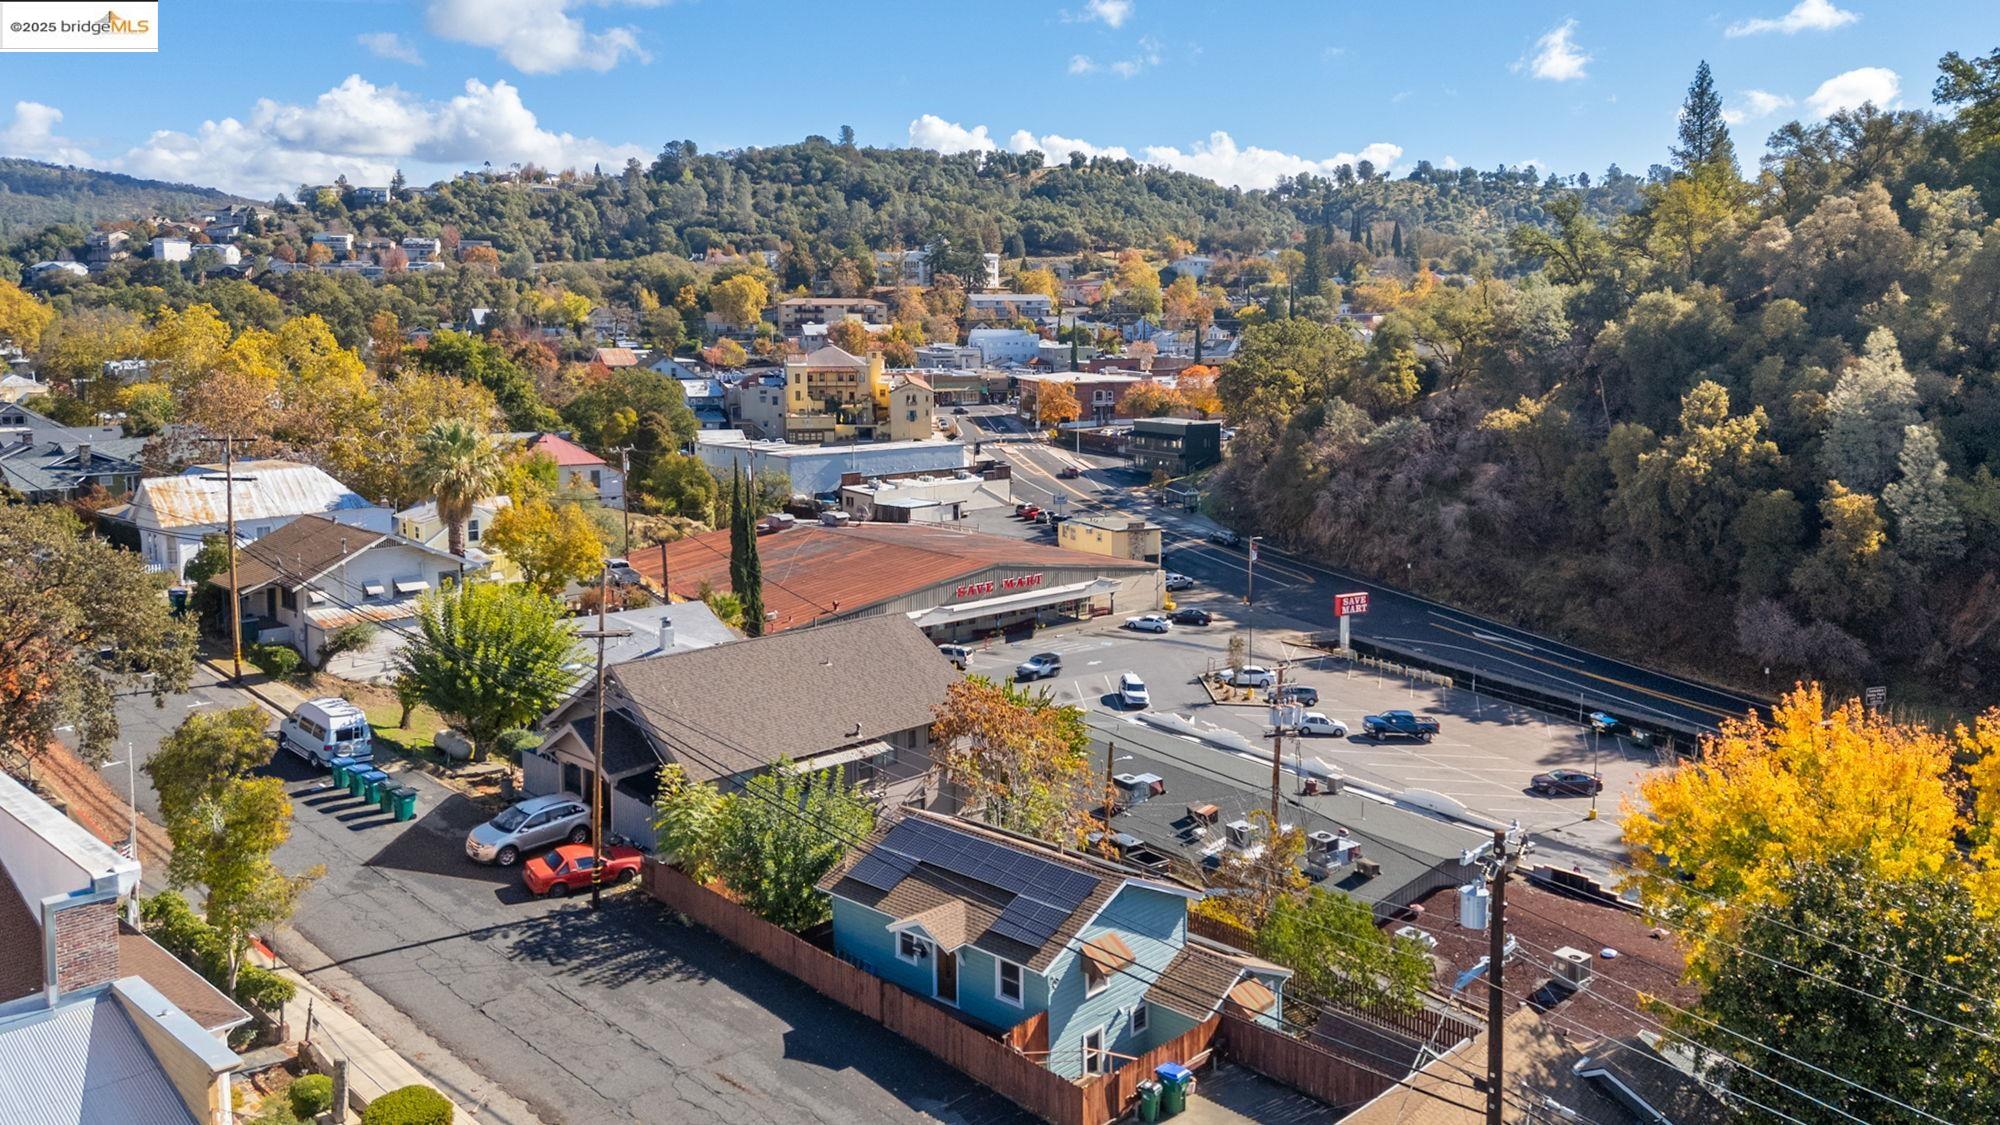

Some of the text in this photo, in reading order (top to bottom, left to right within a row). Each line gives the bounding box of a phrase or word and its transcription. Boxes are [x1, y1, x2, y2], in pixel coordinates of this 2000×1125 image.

[956, 573, 1043, 598] SAVE MART
[1342, 595, 1367, 606] SAVE
[1341, 603, 1368, 615] MART
